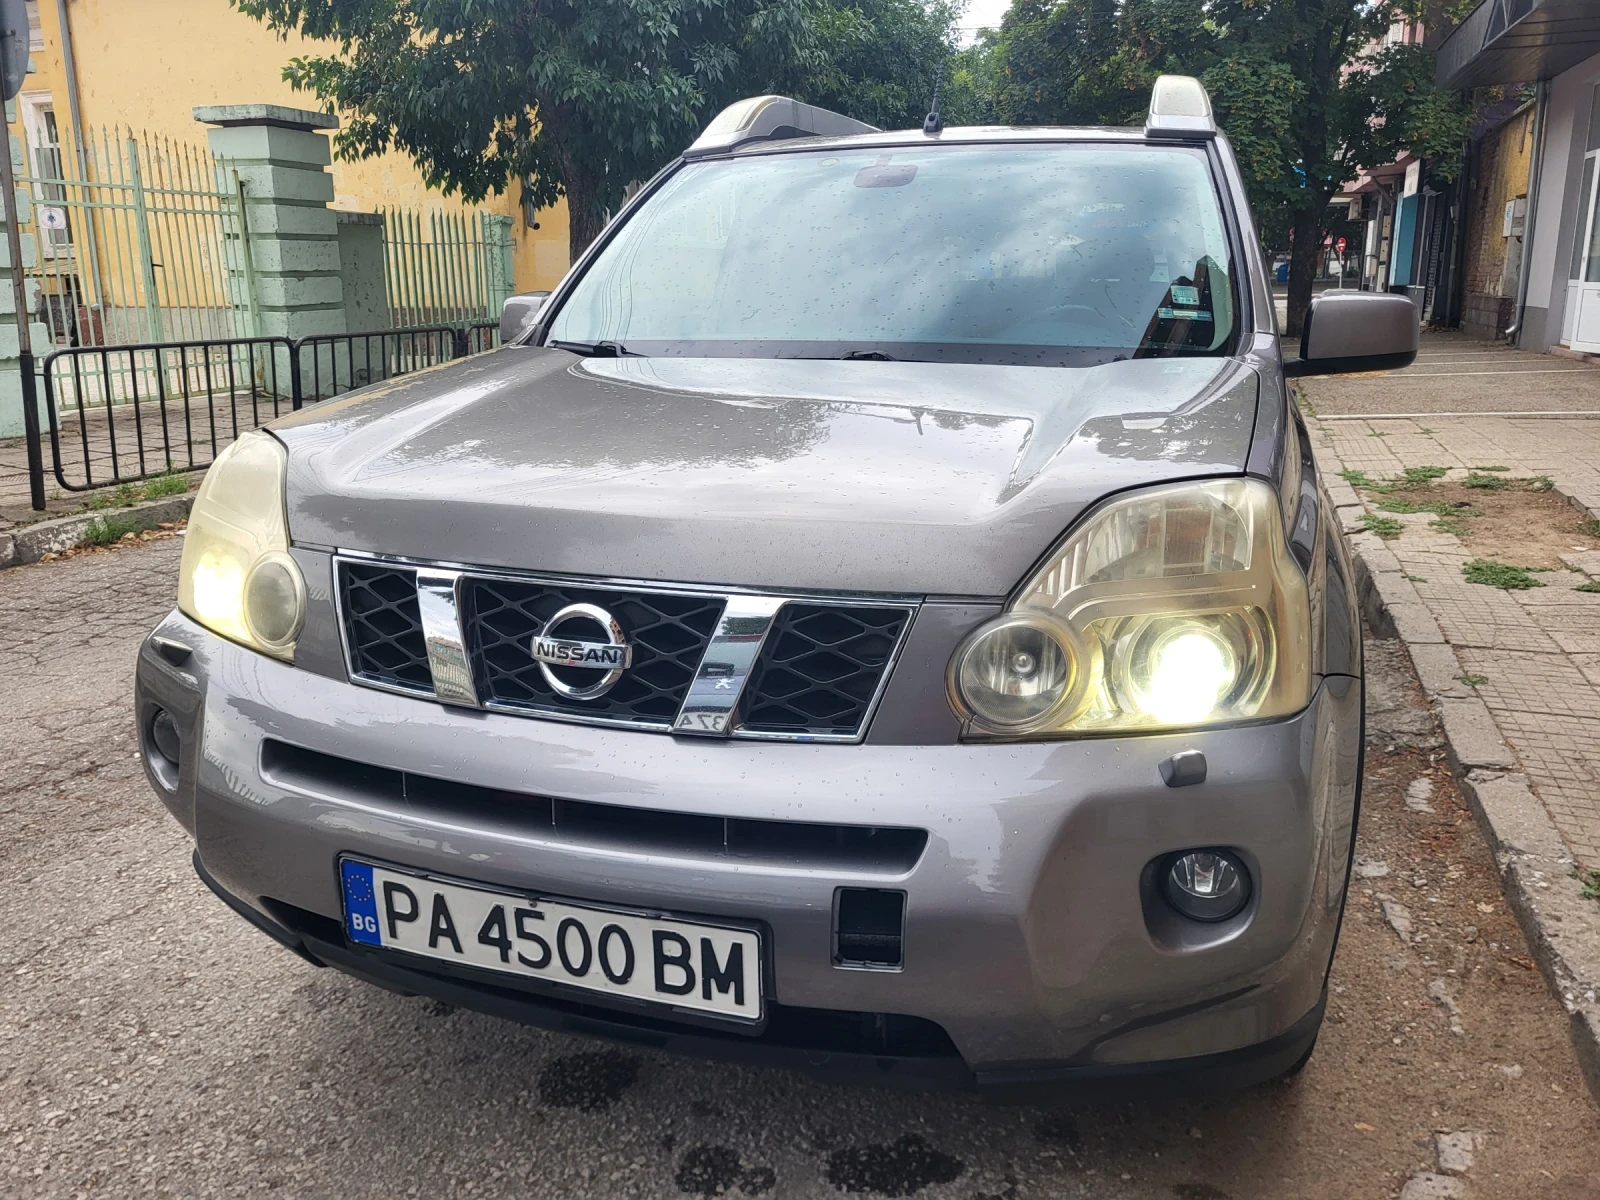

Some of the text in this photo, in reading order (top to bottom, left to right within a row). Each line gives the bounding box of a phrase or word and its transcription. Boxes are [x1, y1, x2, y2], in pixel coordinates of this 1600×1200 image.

[537, 642, 618, 664] NISSAN
[351, 912, 377, 933] BG
[383, 880, 745, 1006] PA 4500 BM
